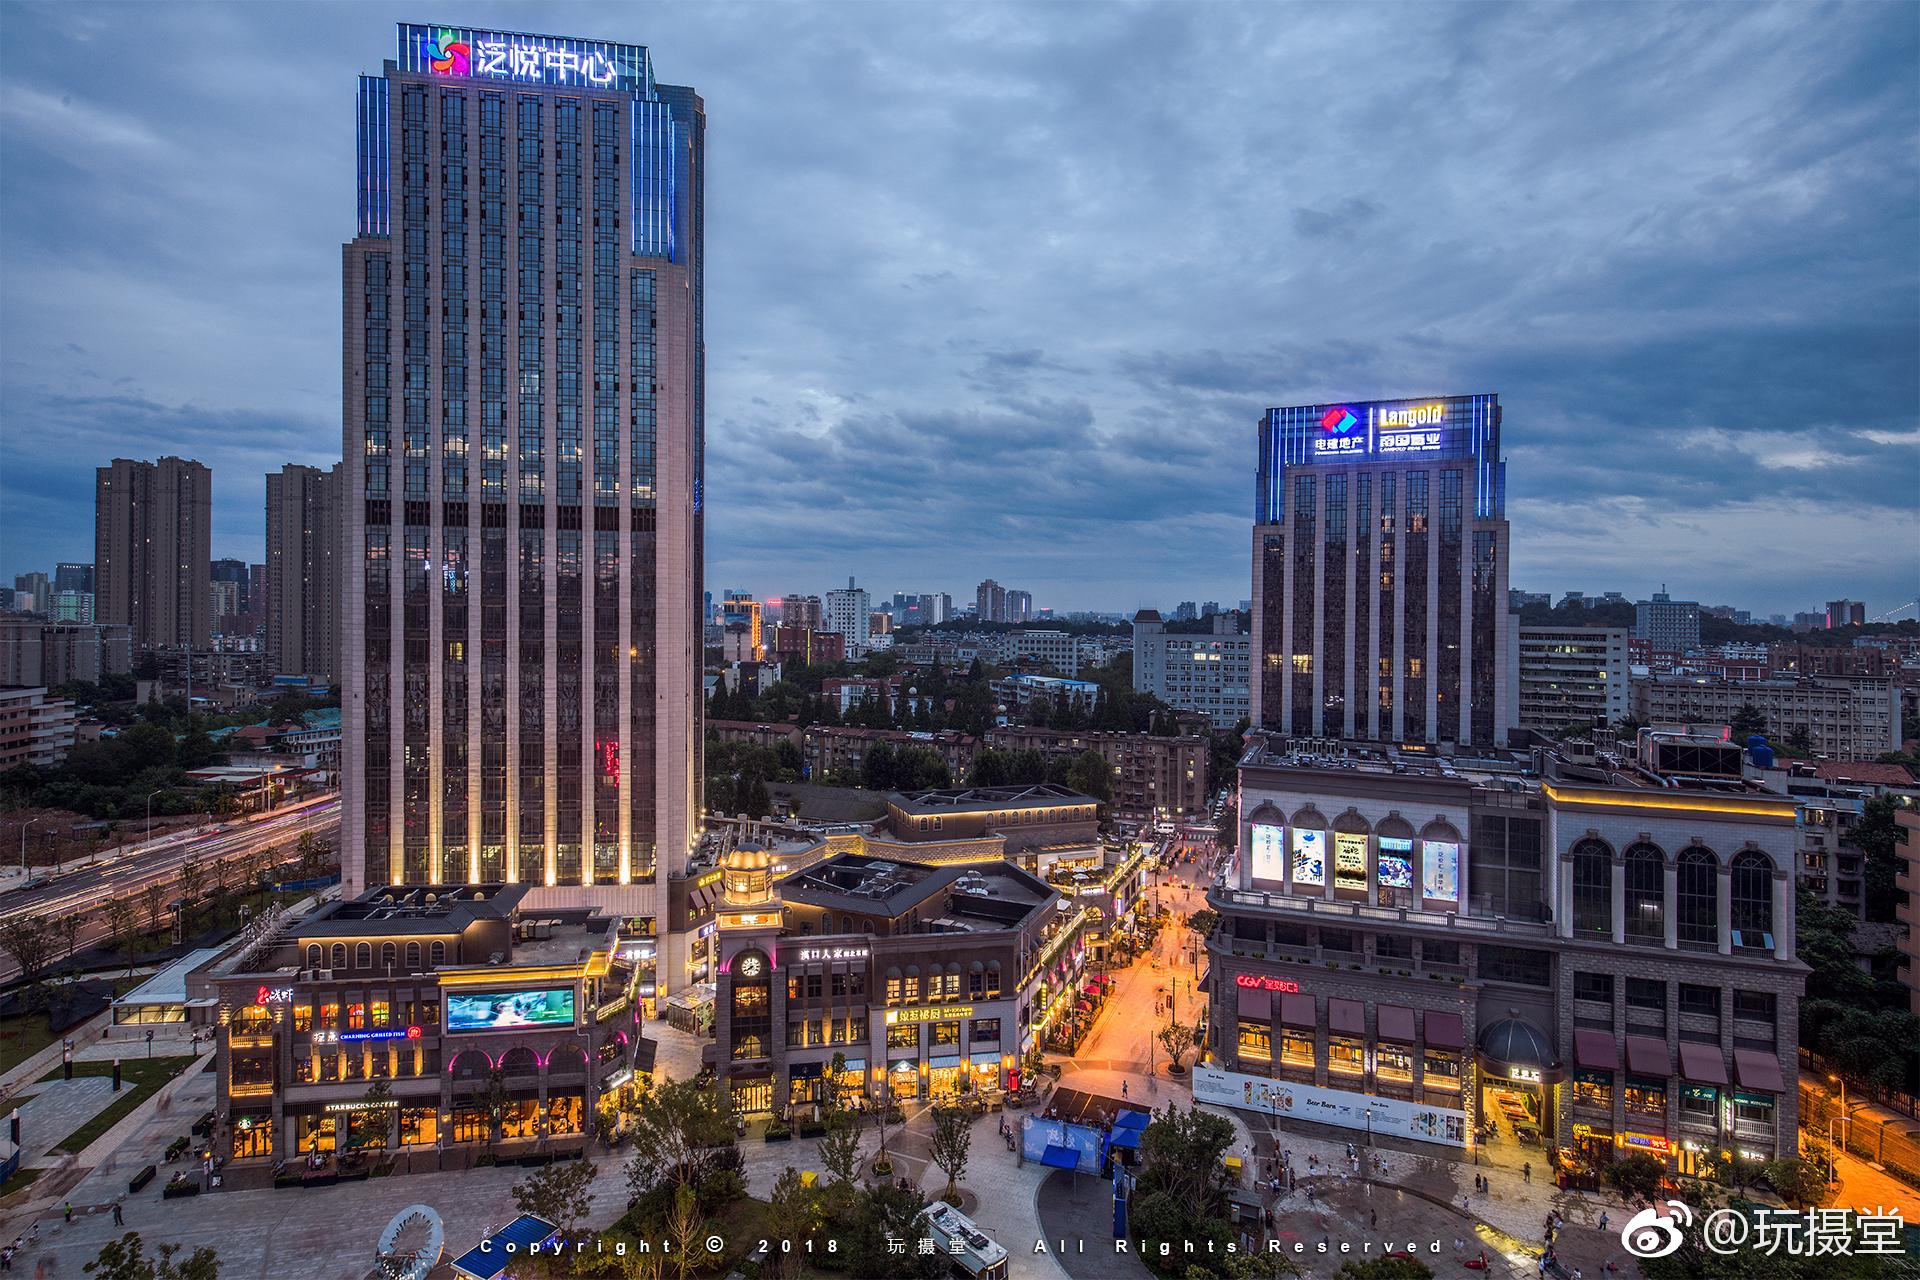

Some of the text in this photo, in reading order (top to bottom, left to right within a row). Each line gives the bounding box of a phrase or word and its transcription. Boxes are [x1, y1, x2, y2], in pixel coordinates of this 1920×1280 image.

[476, 39, 617, 83] 泛悦中心
[1380, 405, 1441, 428] Langold
[1237, 975, 1262, 988] CGV
[340, 1032, 370, 1040] CHARMING
[325, 1100, 399, 1112] STARBUCKS COFFEE
[1306, 1098, 1320, 1107] Beer
[1321, 1101, 1336, 1110] Barn
